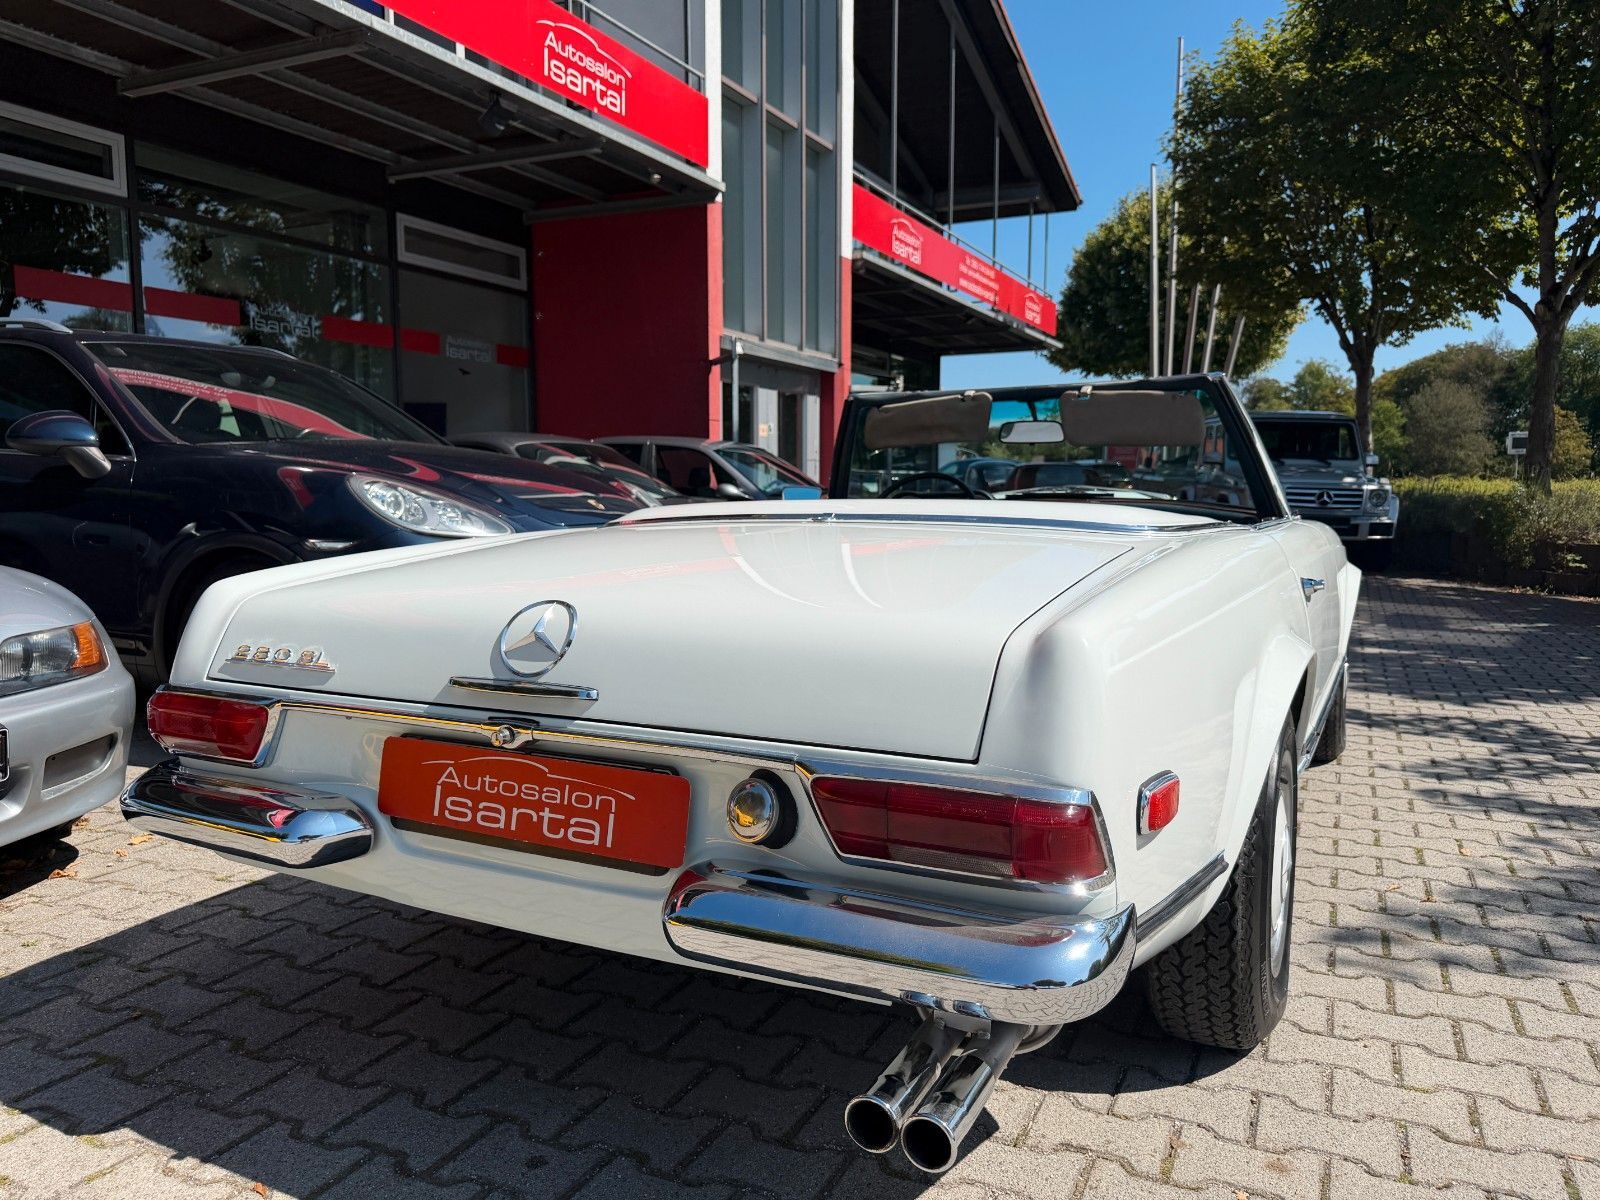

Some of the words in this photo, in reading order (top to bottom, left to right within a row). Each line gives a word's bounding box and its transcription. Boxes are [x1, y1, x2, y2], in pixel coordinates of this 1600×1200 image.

[543, 47, 626, 117] Isartal
[544, 31, 626, 89] Autosalon
[249, 314, 316, 338] Isartal
[446, 343, 492, 363] Isartal
[433, 784, 616, 848] Isartal
[436, 766, 617, 814] Autosalon
